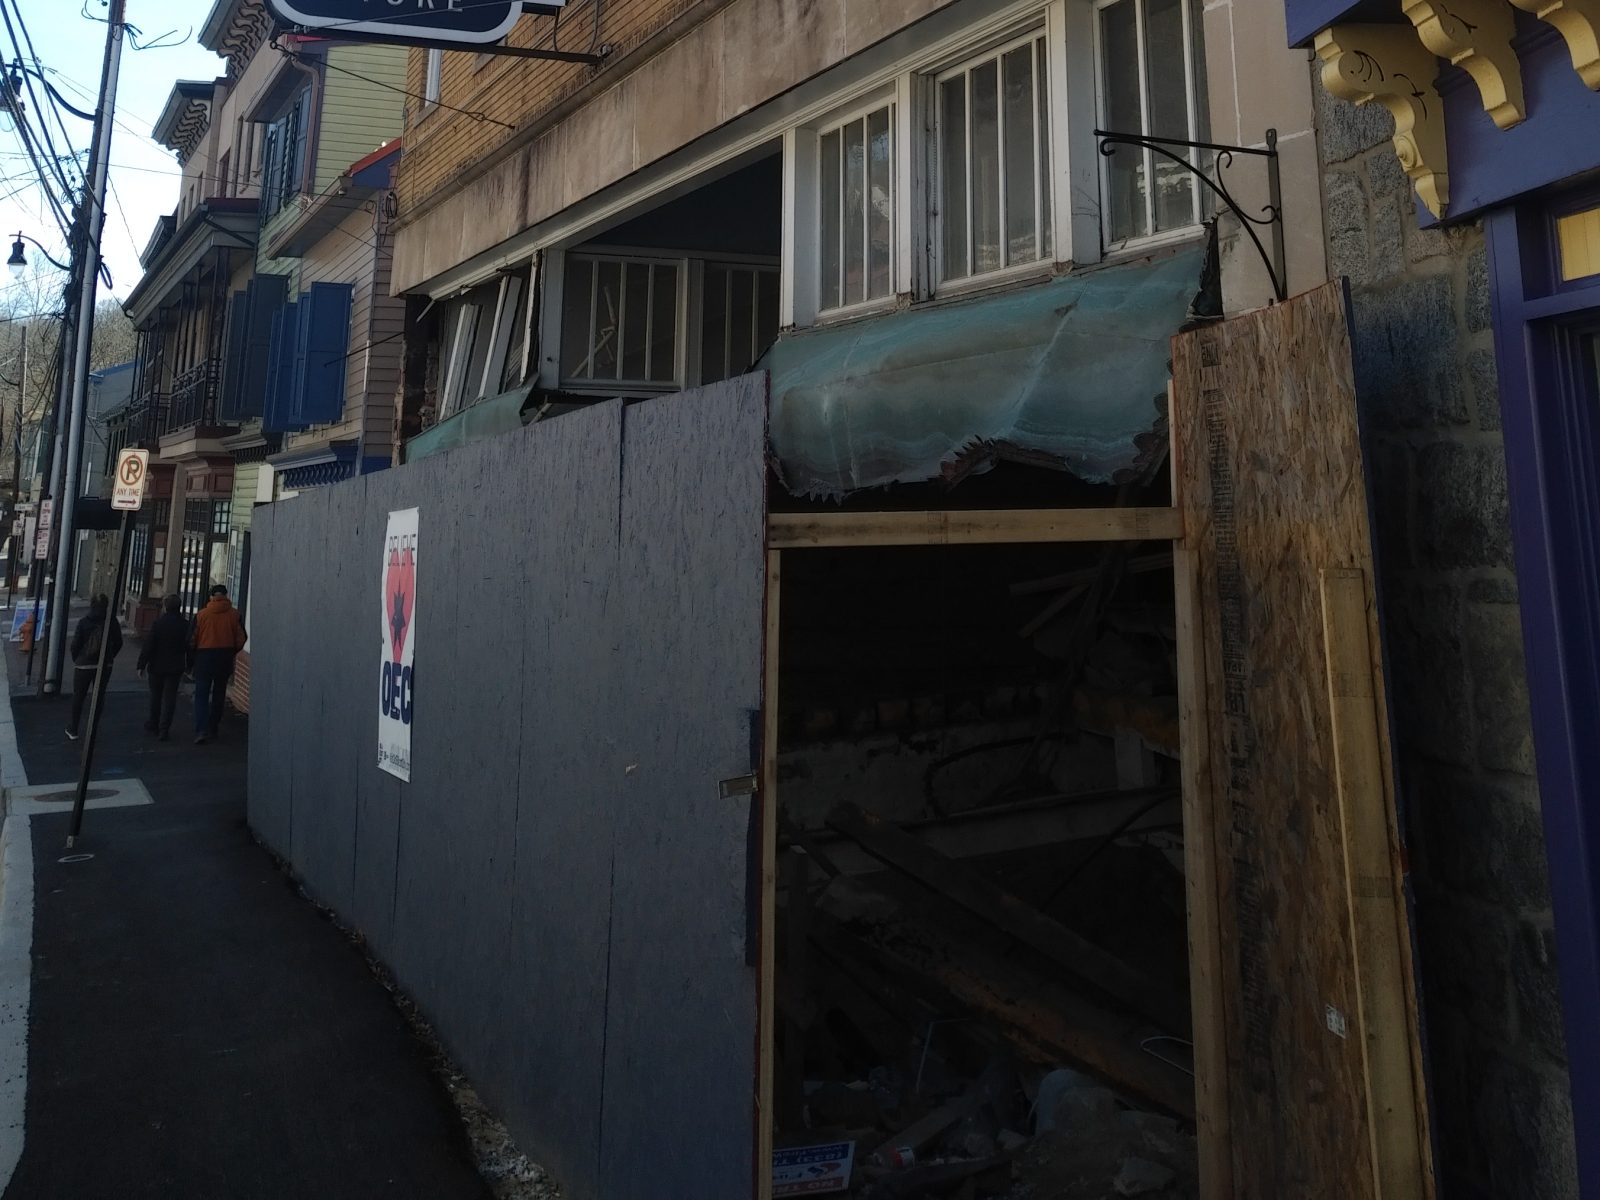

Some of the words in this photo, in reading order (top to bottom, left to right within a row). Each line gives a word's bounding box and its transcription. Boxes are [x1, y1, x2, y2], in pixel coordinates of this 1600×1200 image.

[116, 487, 128, 496] ANY
[128, 488, 141, 497] TIME
[381, 660, 411, 725] OEC
